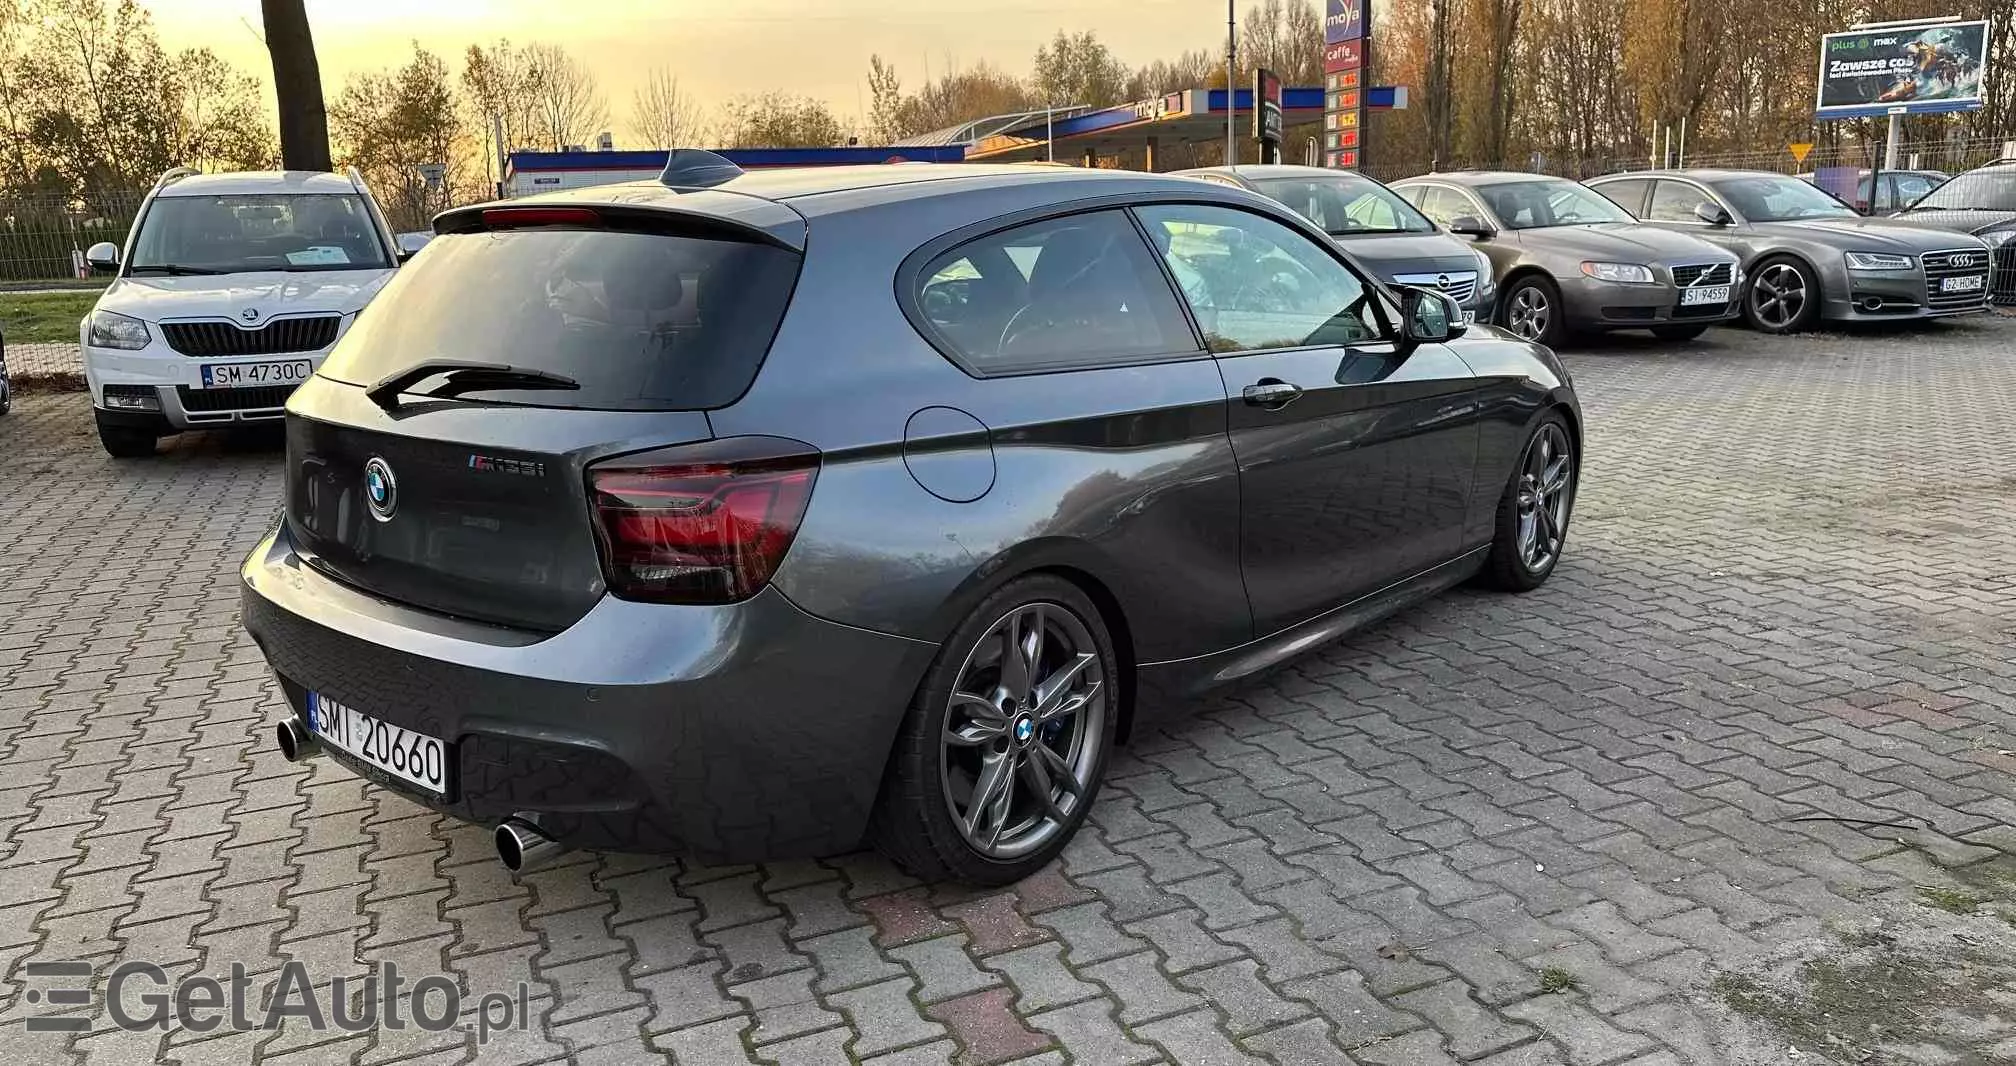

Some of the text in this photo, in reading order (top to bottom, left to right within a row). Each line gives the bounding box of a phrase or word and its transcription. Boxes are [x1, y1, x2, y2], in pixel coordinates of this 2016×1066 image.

[1327, 2, 1360, 33] moya
[1832, 37, 1898, 52] plus max
[1327, 46, 1350, 61] caffe
[1830, 59, 1887, 72] Zawsze
[1945, 276, 1980, 289] G2 HOME
[1687, 288, 1728, 301] SI 94559
[216, 363, 306, 383] SM 4730C
[318, 693, 350, 747] SMI
[361, 714, 442, 785] 20660
